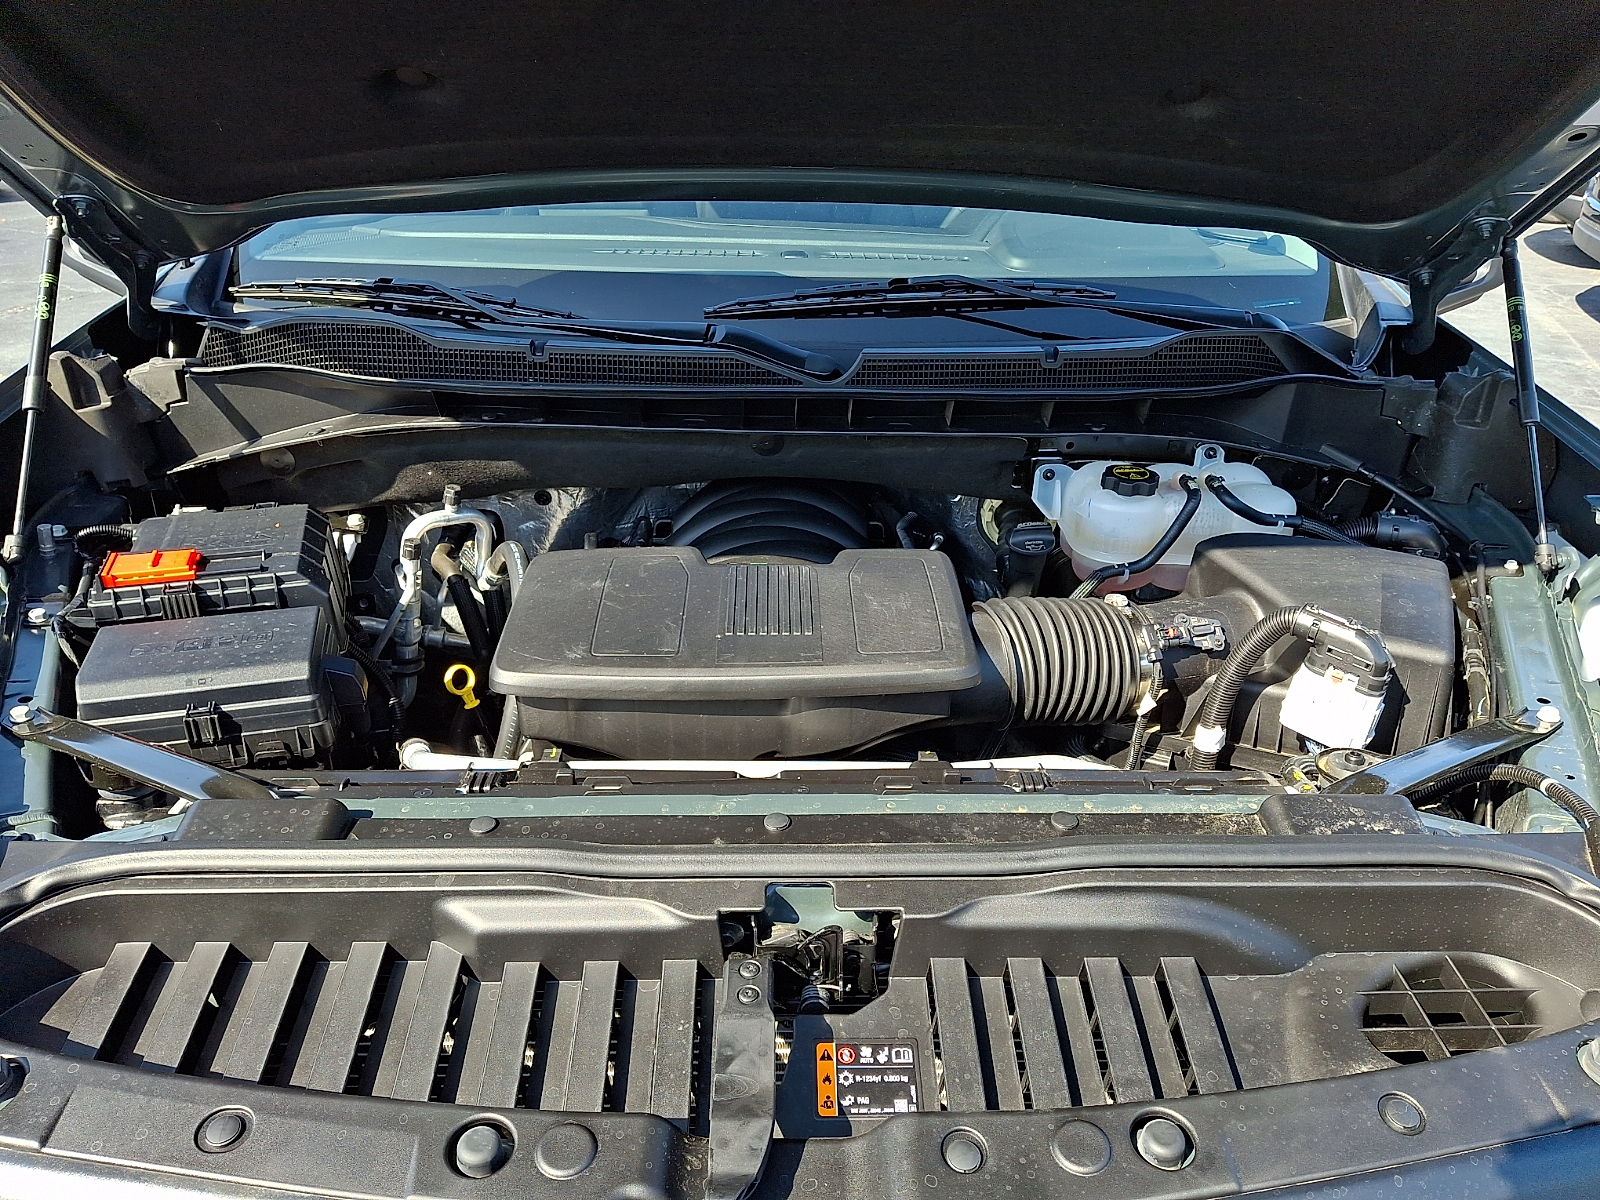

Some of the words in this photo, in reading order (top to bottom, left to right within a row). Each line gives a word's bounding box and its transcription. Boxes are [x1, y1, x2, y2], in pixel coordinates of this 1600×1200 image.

[855, 1075, 882, 1083] R-1234yf
[900, 1075, 909, 1083] kg
[857, 1096, 870, 1105] PAG
